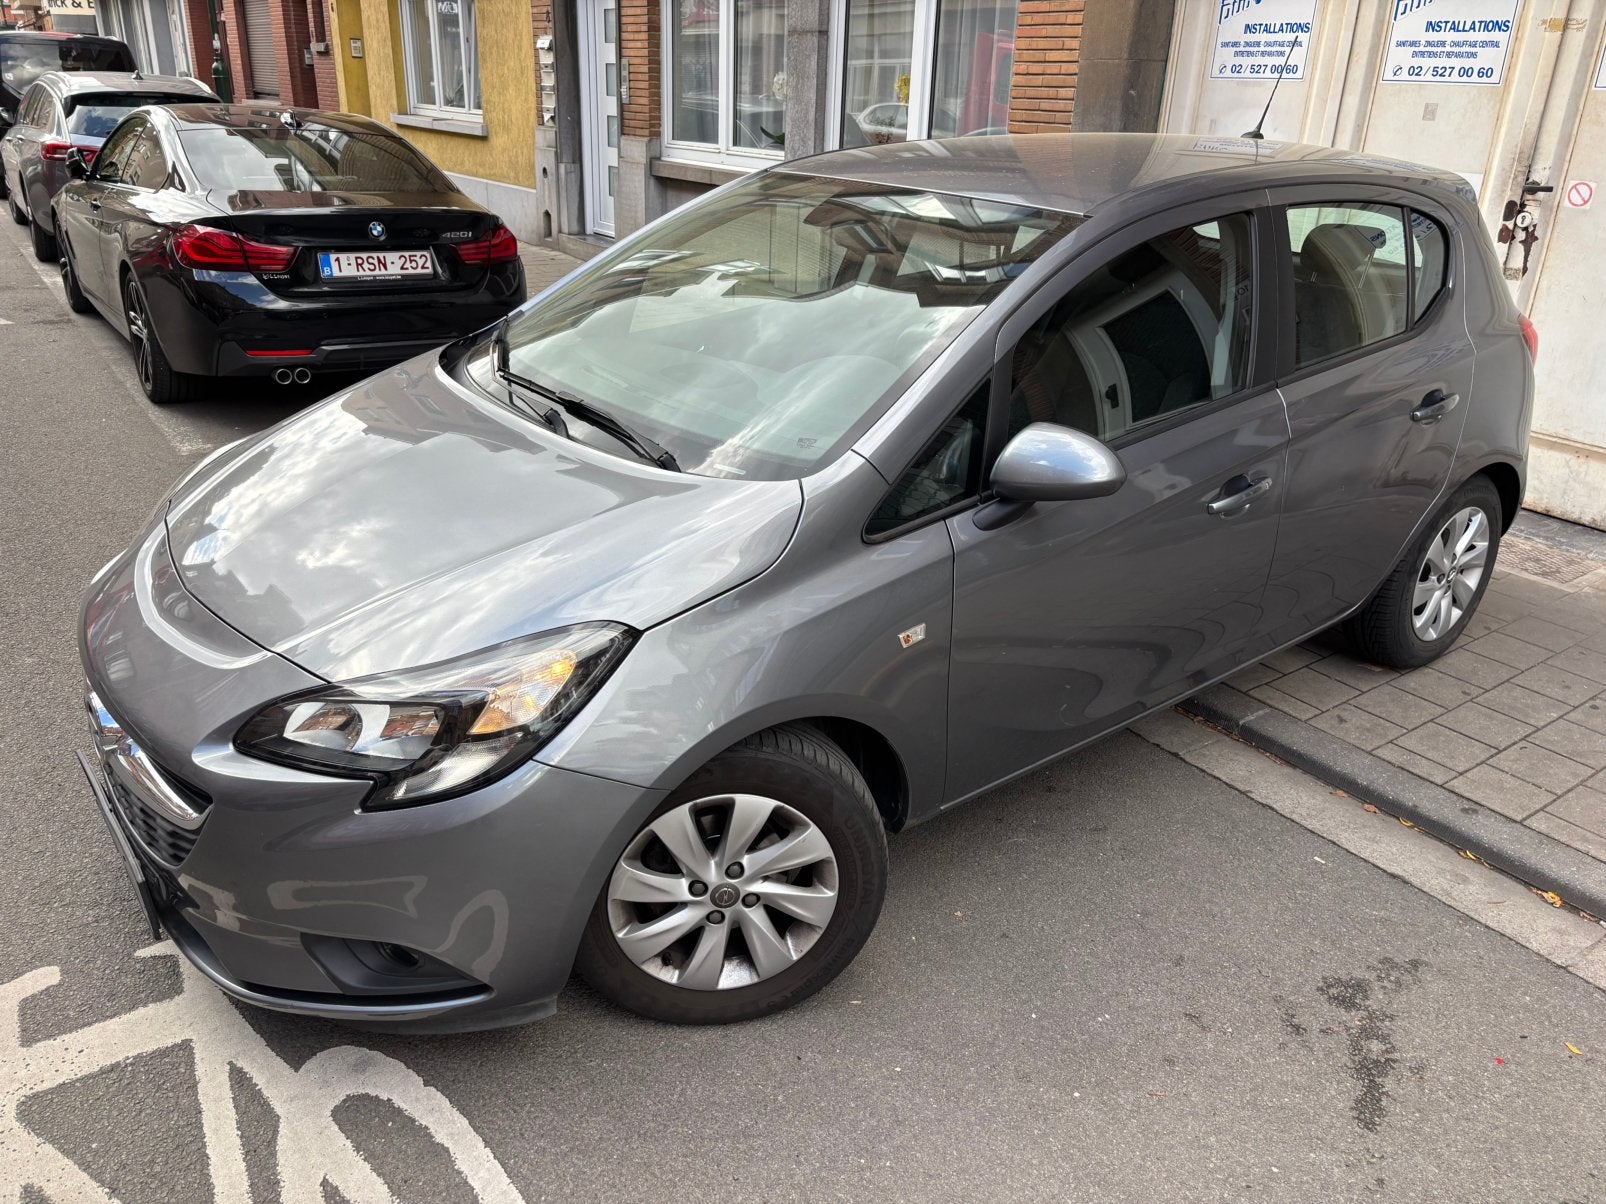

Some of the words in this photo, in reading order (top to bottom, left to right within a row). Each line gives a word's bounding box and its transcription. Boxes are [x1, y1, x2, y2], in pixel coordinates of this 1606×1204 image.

[1244, 22, 1310, 34] INSTALLATIONS
[1425, 20, 1511, 33] INSTALLATIONS
[1395, 40, 1421, 48] SANITAIRES
[1423, 40, 1447, 48] ZINGUERIE
[1450, 40, 1478, 48] CHAUFFAGE
[1445, 51, 1478, 59] REPARATIONS
[1270, 64, 1283, 75] 00
[1285, 64, 1299, 75] 60
[1458, 66, 1474, 78] 00
[1477, 67, 1494, 79] 60
[324, 267, 331, 275] B
